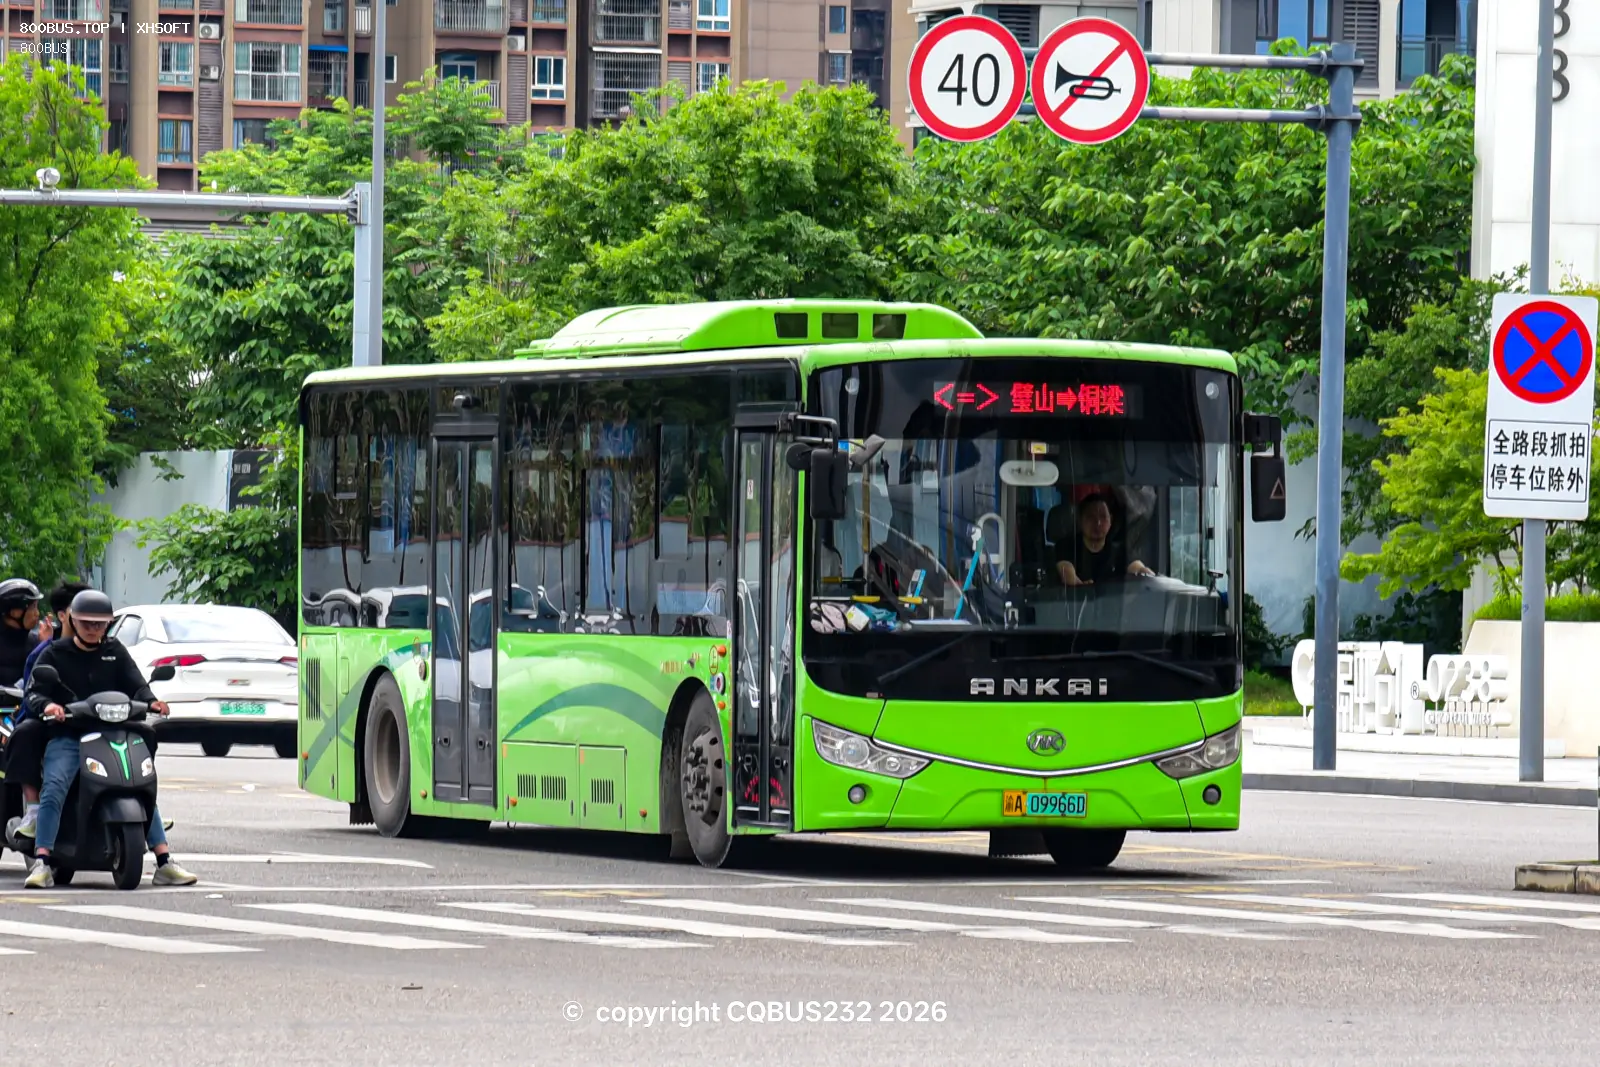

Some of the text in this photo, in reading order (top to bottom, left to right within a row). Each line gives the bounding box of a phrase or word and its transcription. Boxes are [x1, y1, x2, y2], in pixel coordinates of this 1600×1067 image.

[937, 53, 1000, 107] 40
[1078, 383, 1124, 415] 铜梁
[1492, 429, 1586, 459] 全路段抓拍
[1490, 463, 1585, 493] 停车位除外
[1030, 795, 1085, 814] 09966D
